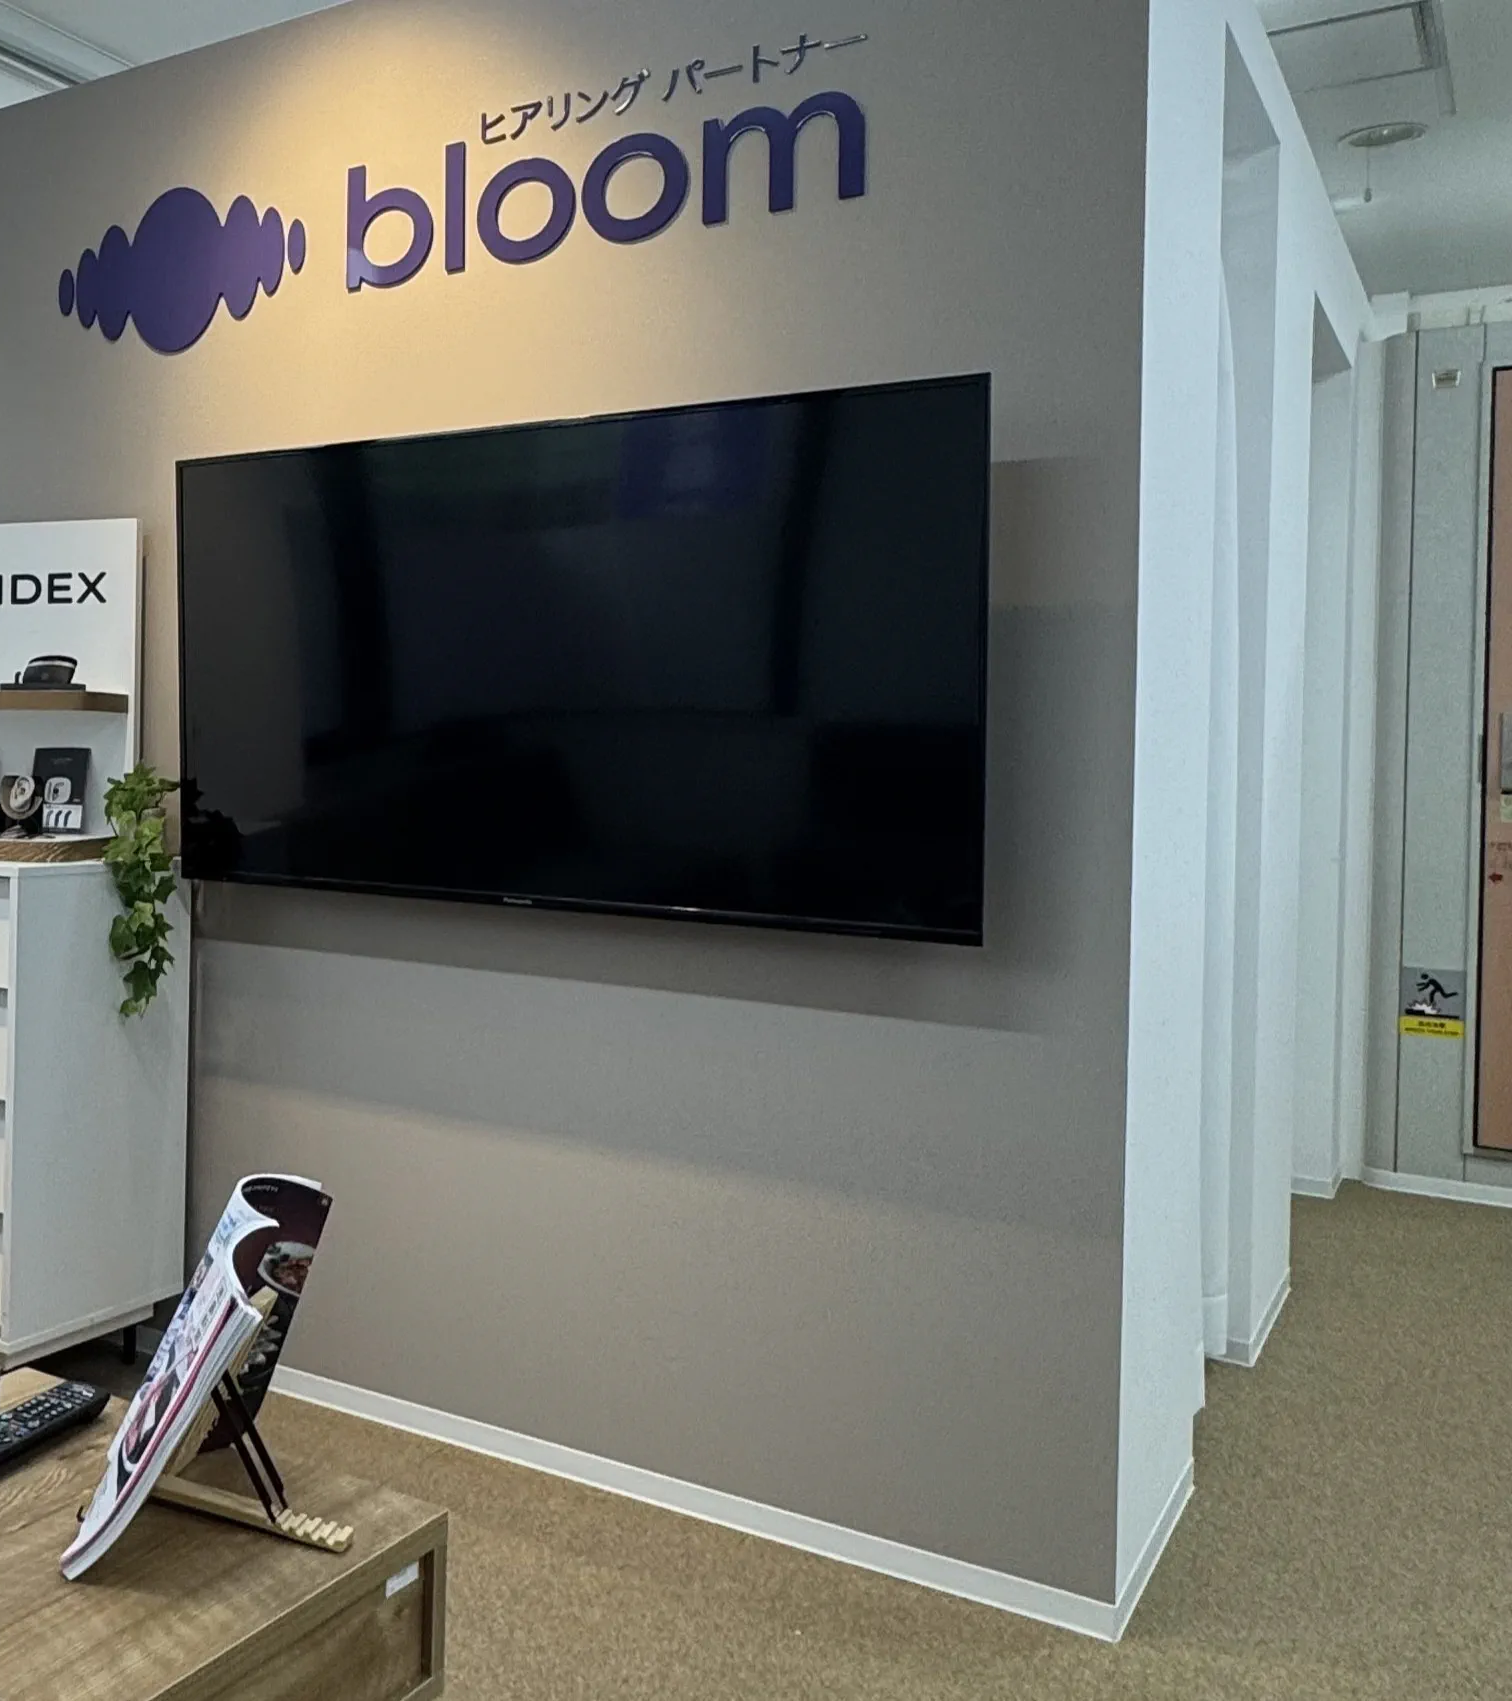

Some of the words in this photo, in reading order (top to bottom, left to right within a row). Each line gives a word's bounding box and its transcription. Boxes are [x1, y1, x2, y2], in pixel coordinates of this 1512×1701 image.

[480, 68, 651, 145] ヒアリング
[661, 32, 868, 101] パートナー
[346, 91, 867, 293] bloom
